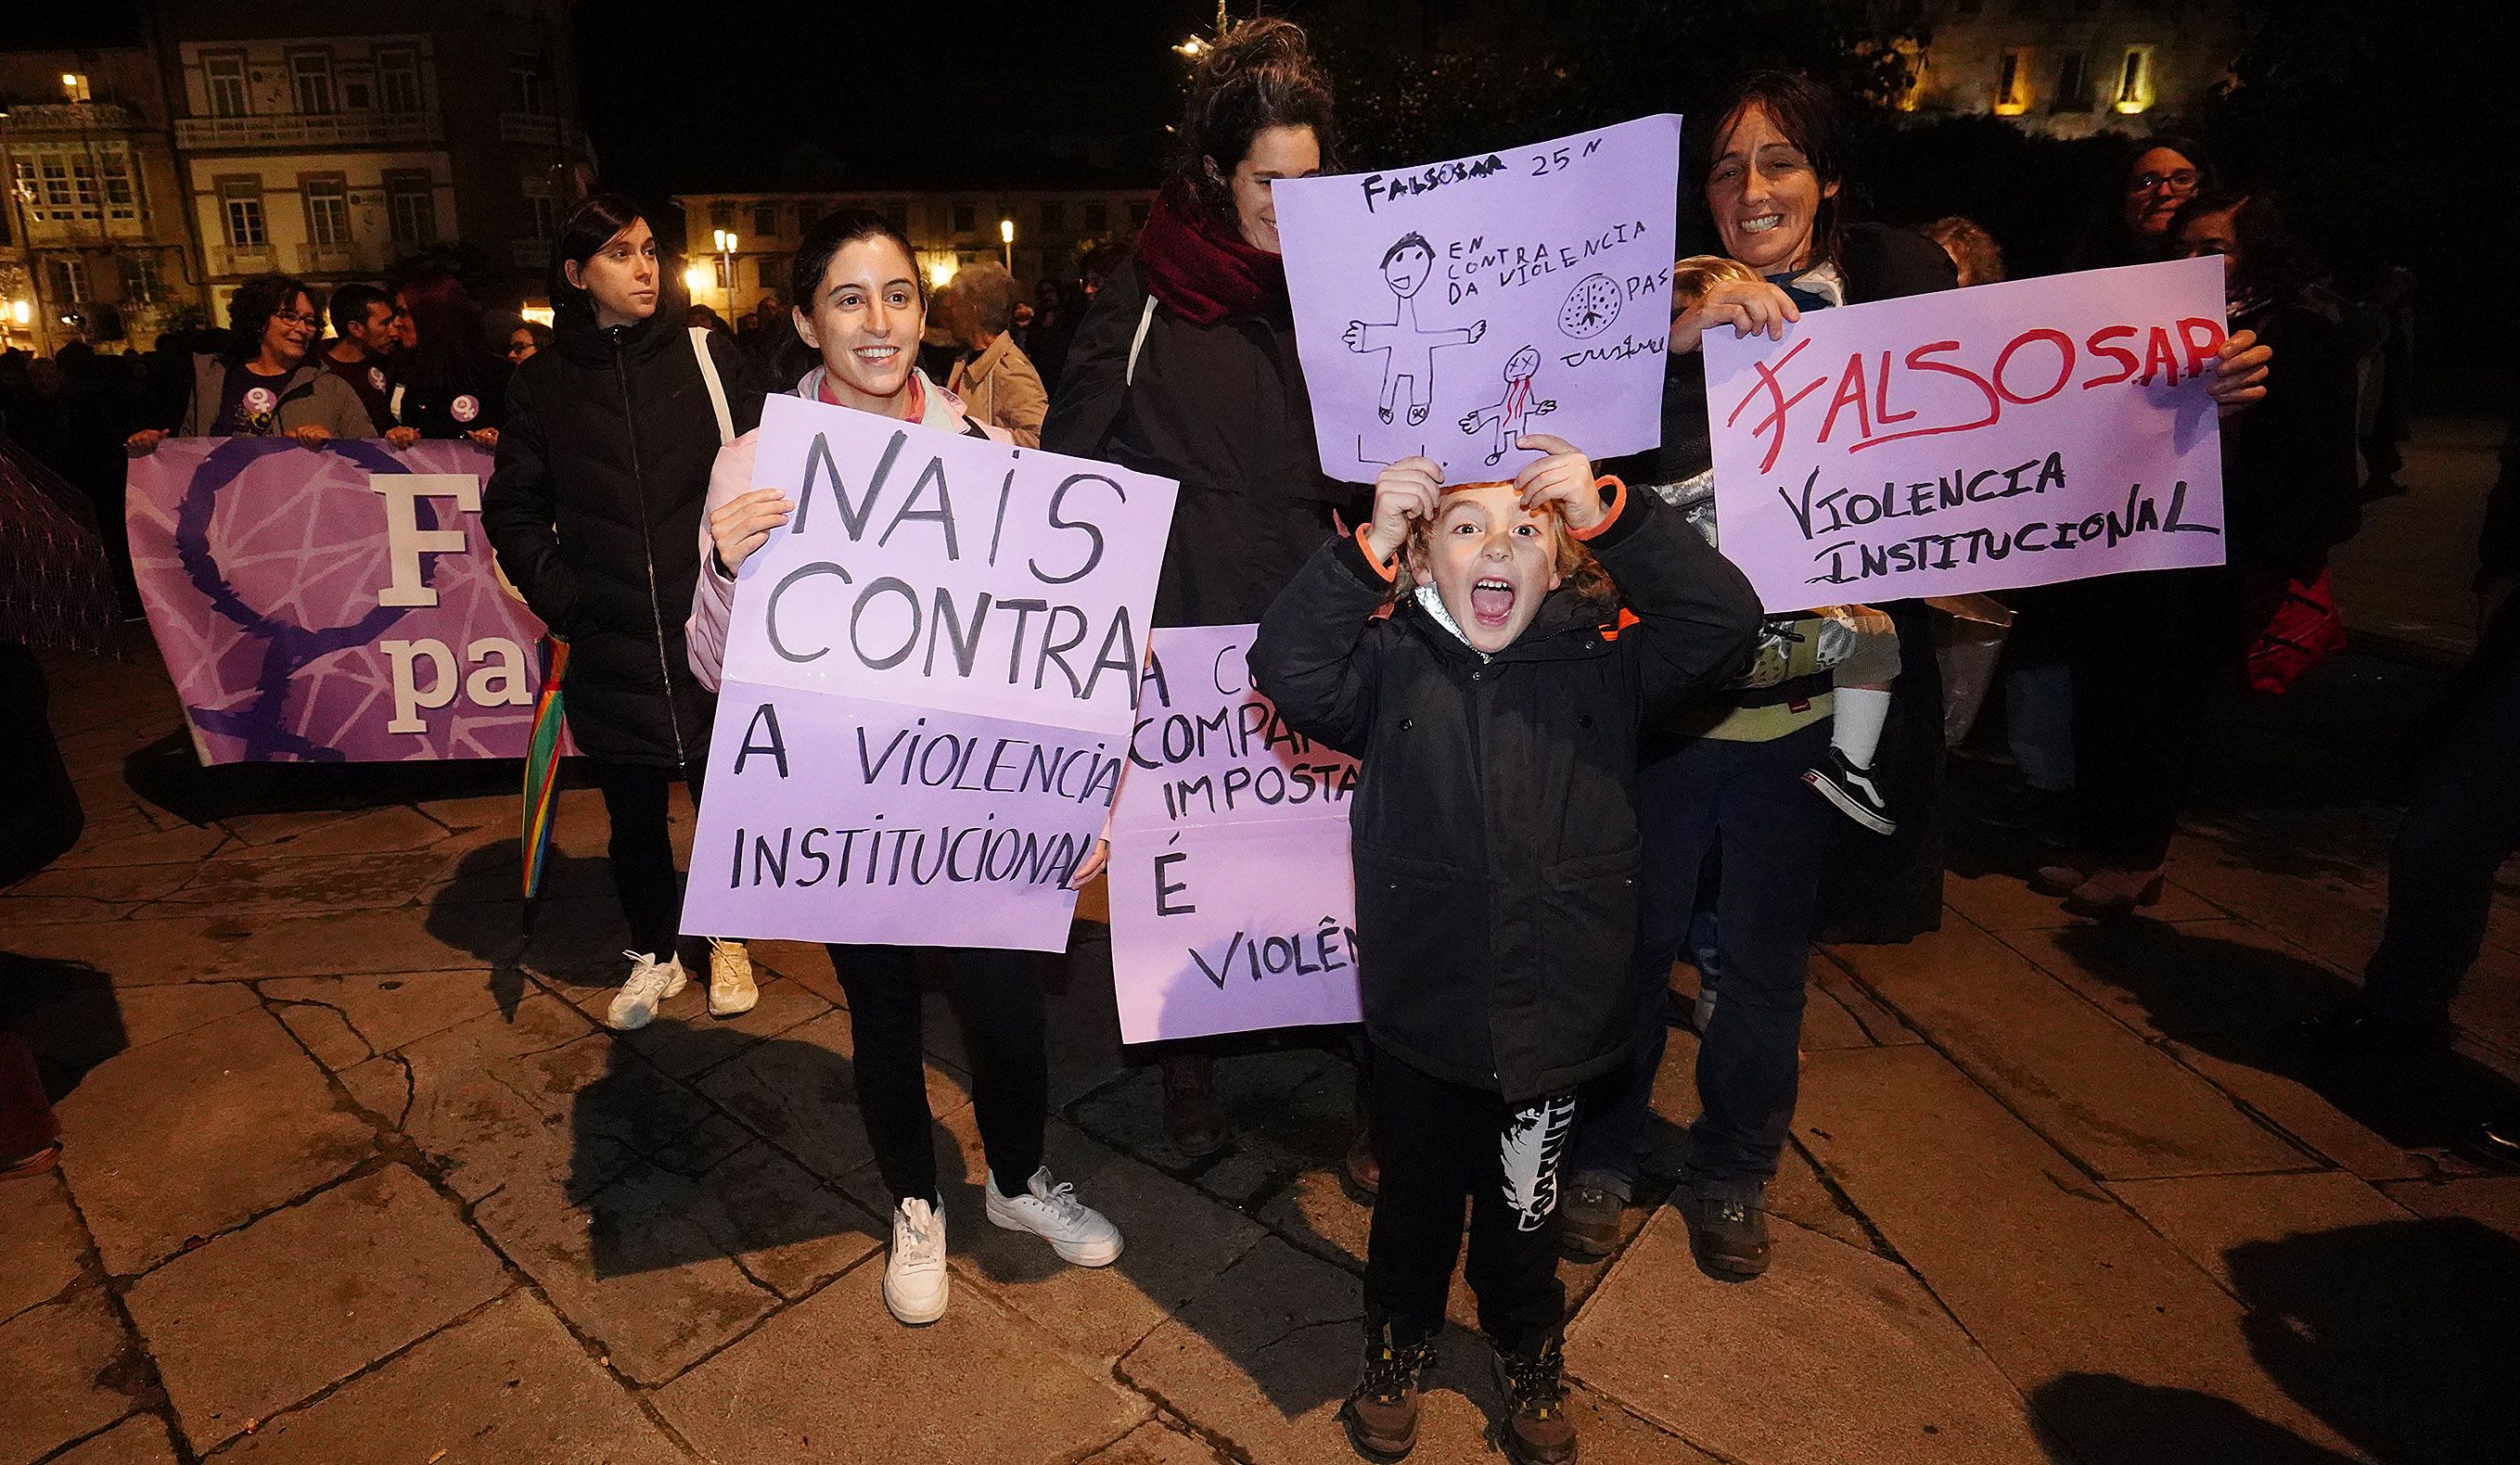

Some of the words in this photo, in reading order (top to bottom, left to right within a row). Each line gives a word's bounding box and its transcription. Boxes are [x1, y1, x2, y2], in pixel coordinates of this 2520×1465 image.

[1361, 154, 1507, 213] FALSOSAR
[1531, 146, 1570, 176] 25
[1448, 243, 1549, 280] CONTRA
[1449, 236, 1484, 260] EN
[1449, 281, 1478, 305] DA
[1499, 221, 1646, 287] VIOLENCIA
[1778, 451, 2066, 541] VIOLENCIA
[1805, 480, 2219, 584] INSTITUCIONAL
[765, 561, 1139, 710] CONTRA
[734, 703, 788, 780] A
[1154, 832, 1196, 917] É
